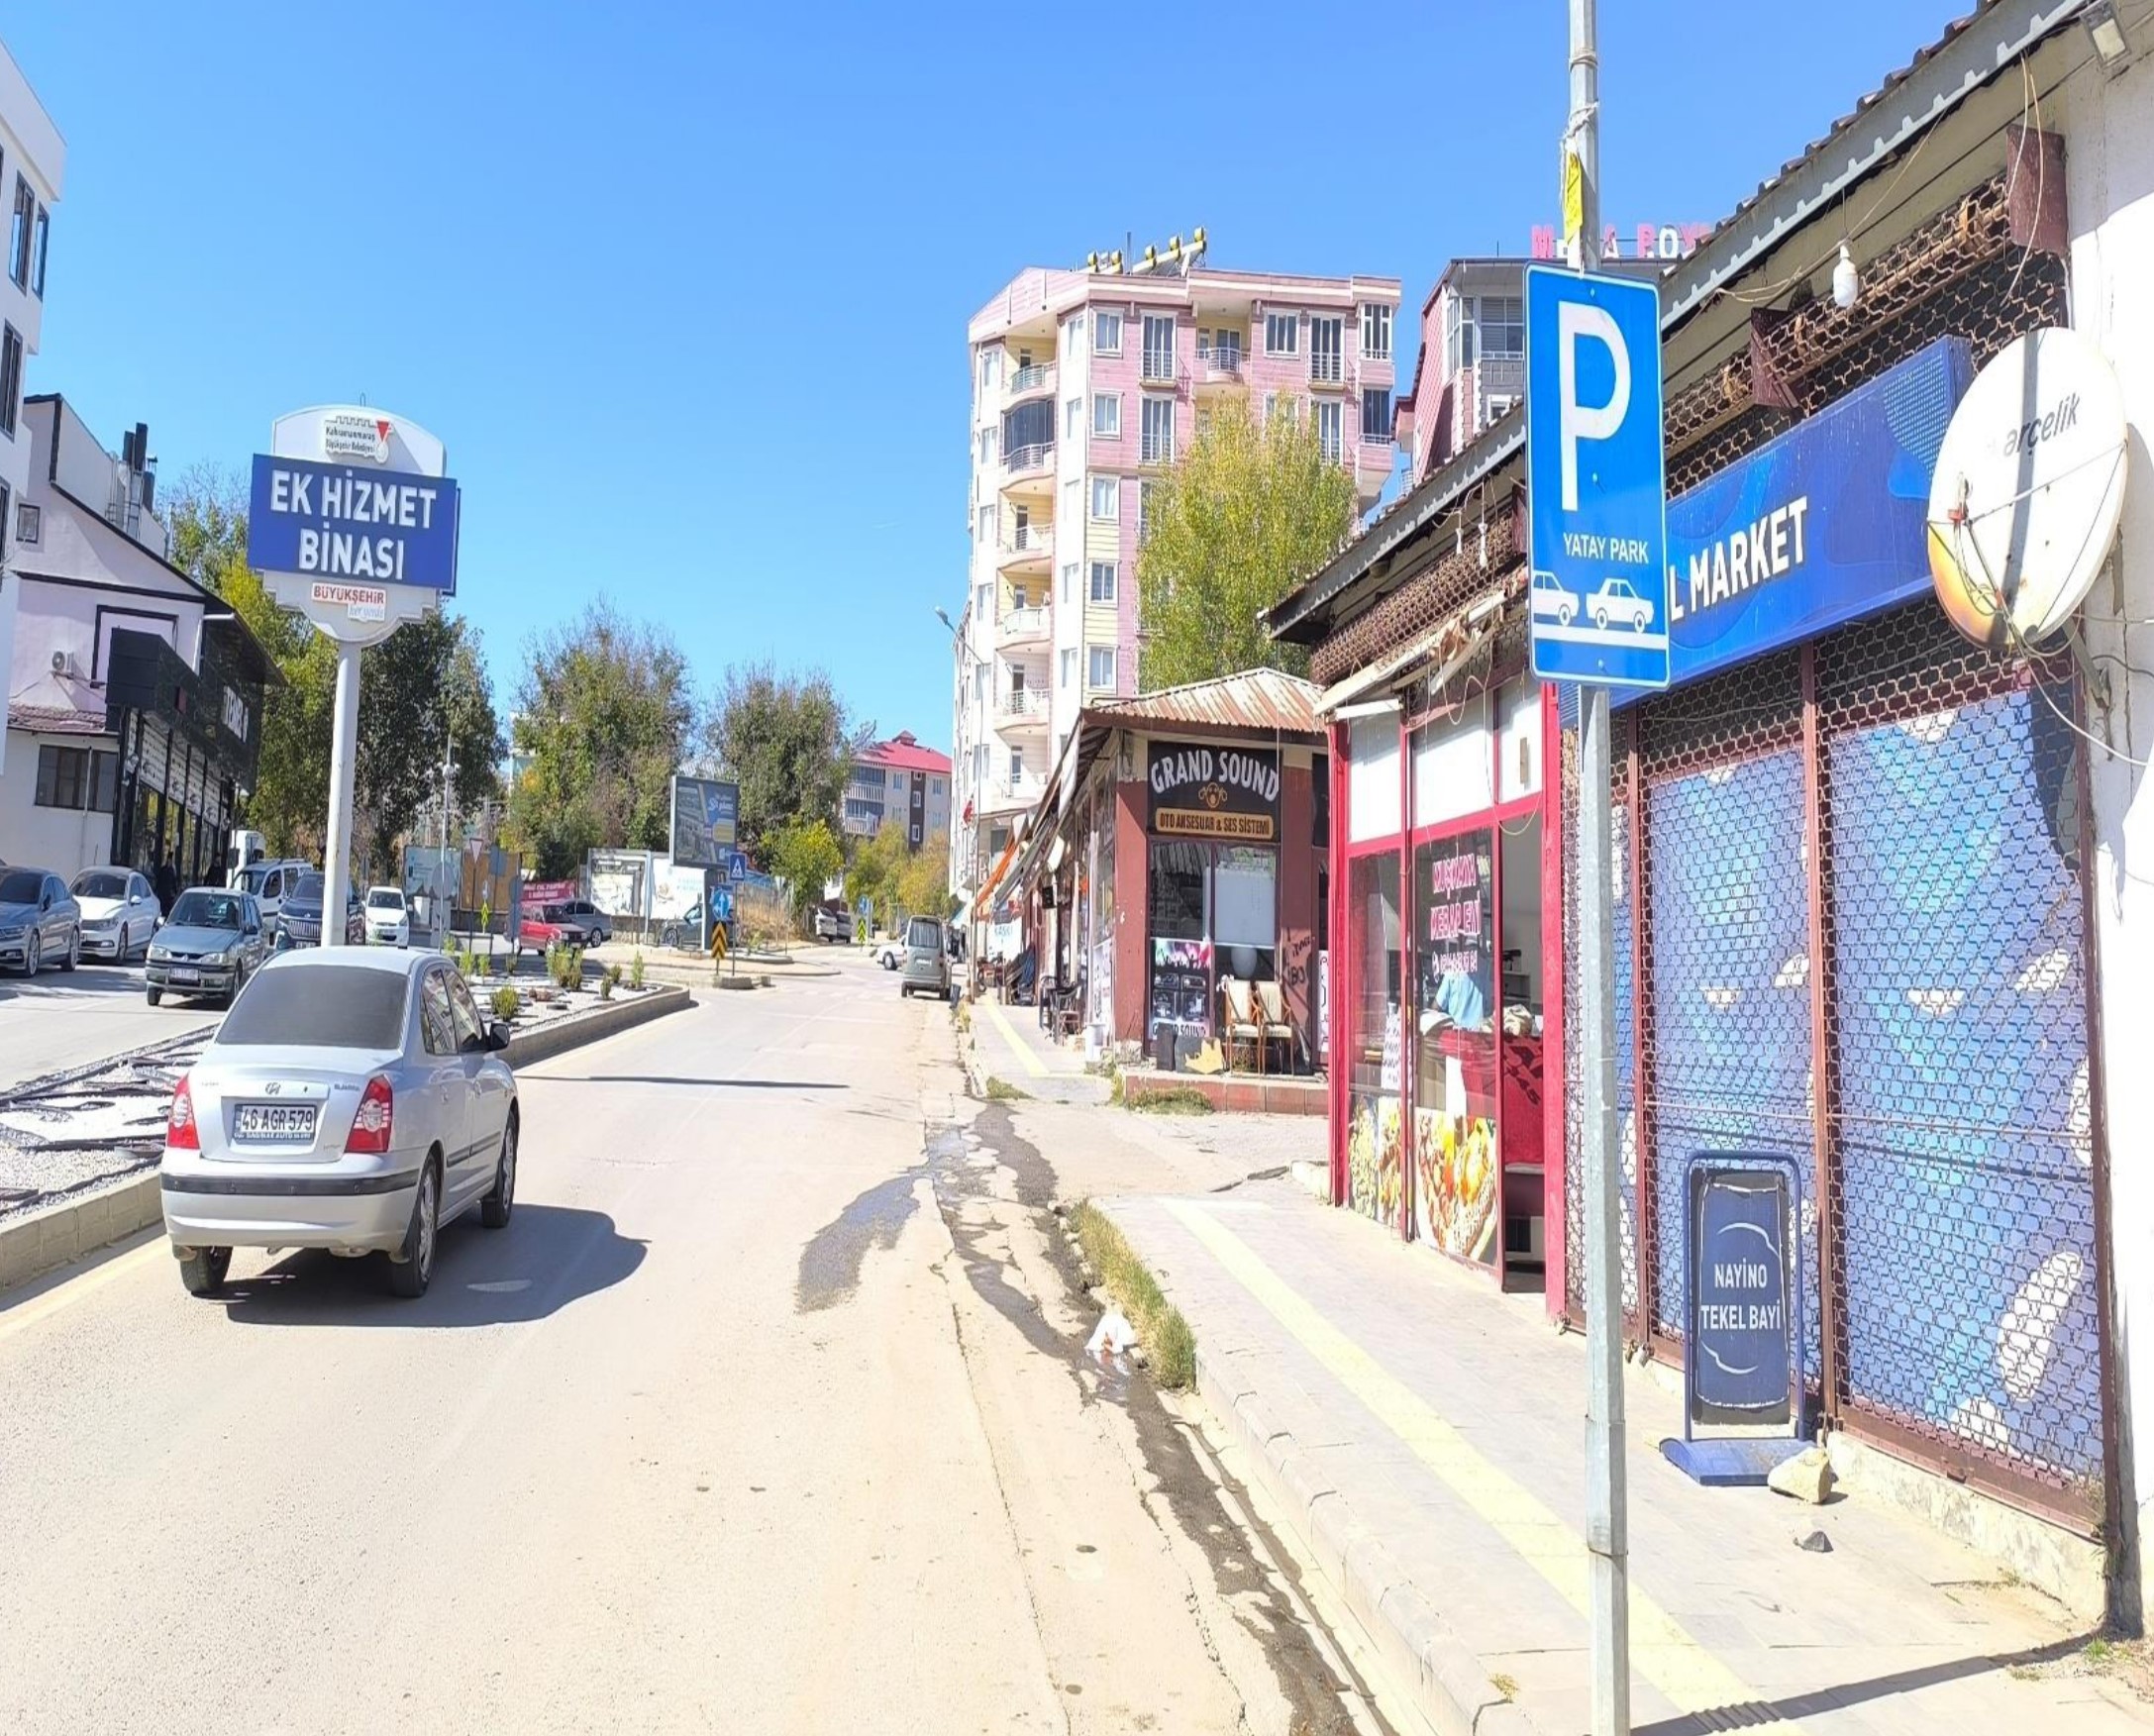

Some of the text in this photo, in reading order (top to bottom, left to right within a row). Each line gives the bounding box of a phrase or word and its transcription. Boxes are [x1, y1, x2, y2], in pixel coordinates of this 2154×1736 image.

[1558, 301, 1631, 512] P
[2002, 392, 2080, 458] arçelik
[270, 468, 437, 529] EK HİZMET
[299, 522, 404, 580] BİNASI
[1563, 532, 1649, 564] YATAY PARK
[1690, 495, 1807, 613] MARKET
[313, 585, 384, 604] BÜYÜKŞEHİR
[1151, 750, 1279, 802] GRAND SOUND
[1160, 812, 1175, 828] OTO
[1176, 813, 1215, 831] AKSESUAR
[1223, 817, 1236, 833] SES
[242, 1108, 313, 1131] 46 AGR 579
[1713, 1258, 1767, 1288] NAYİNO
[1700, 1298, 1781, 1330] TEKEL BAYİ
